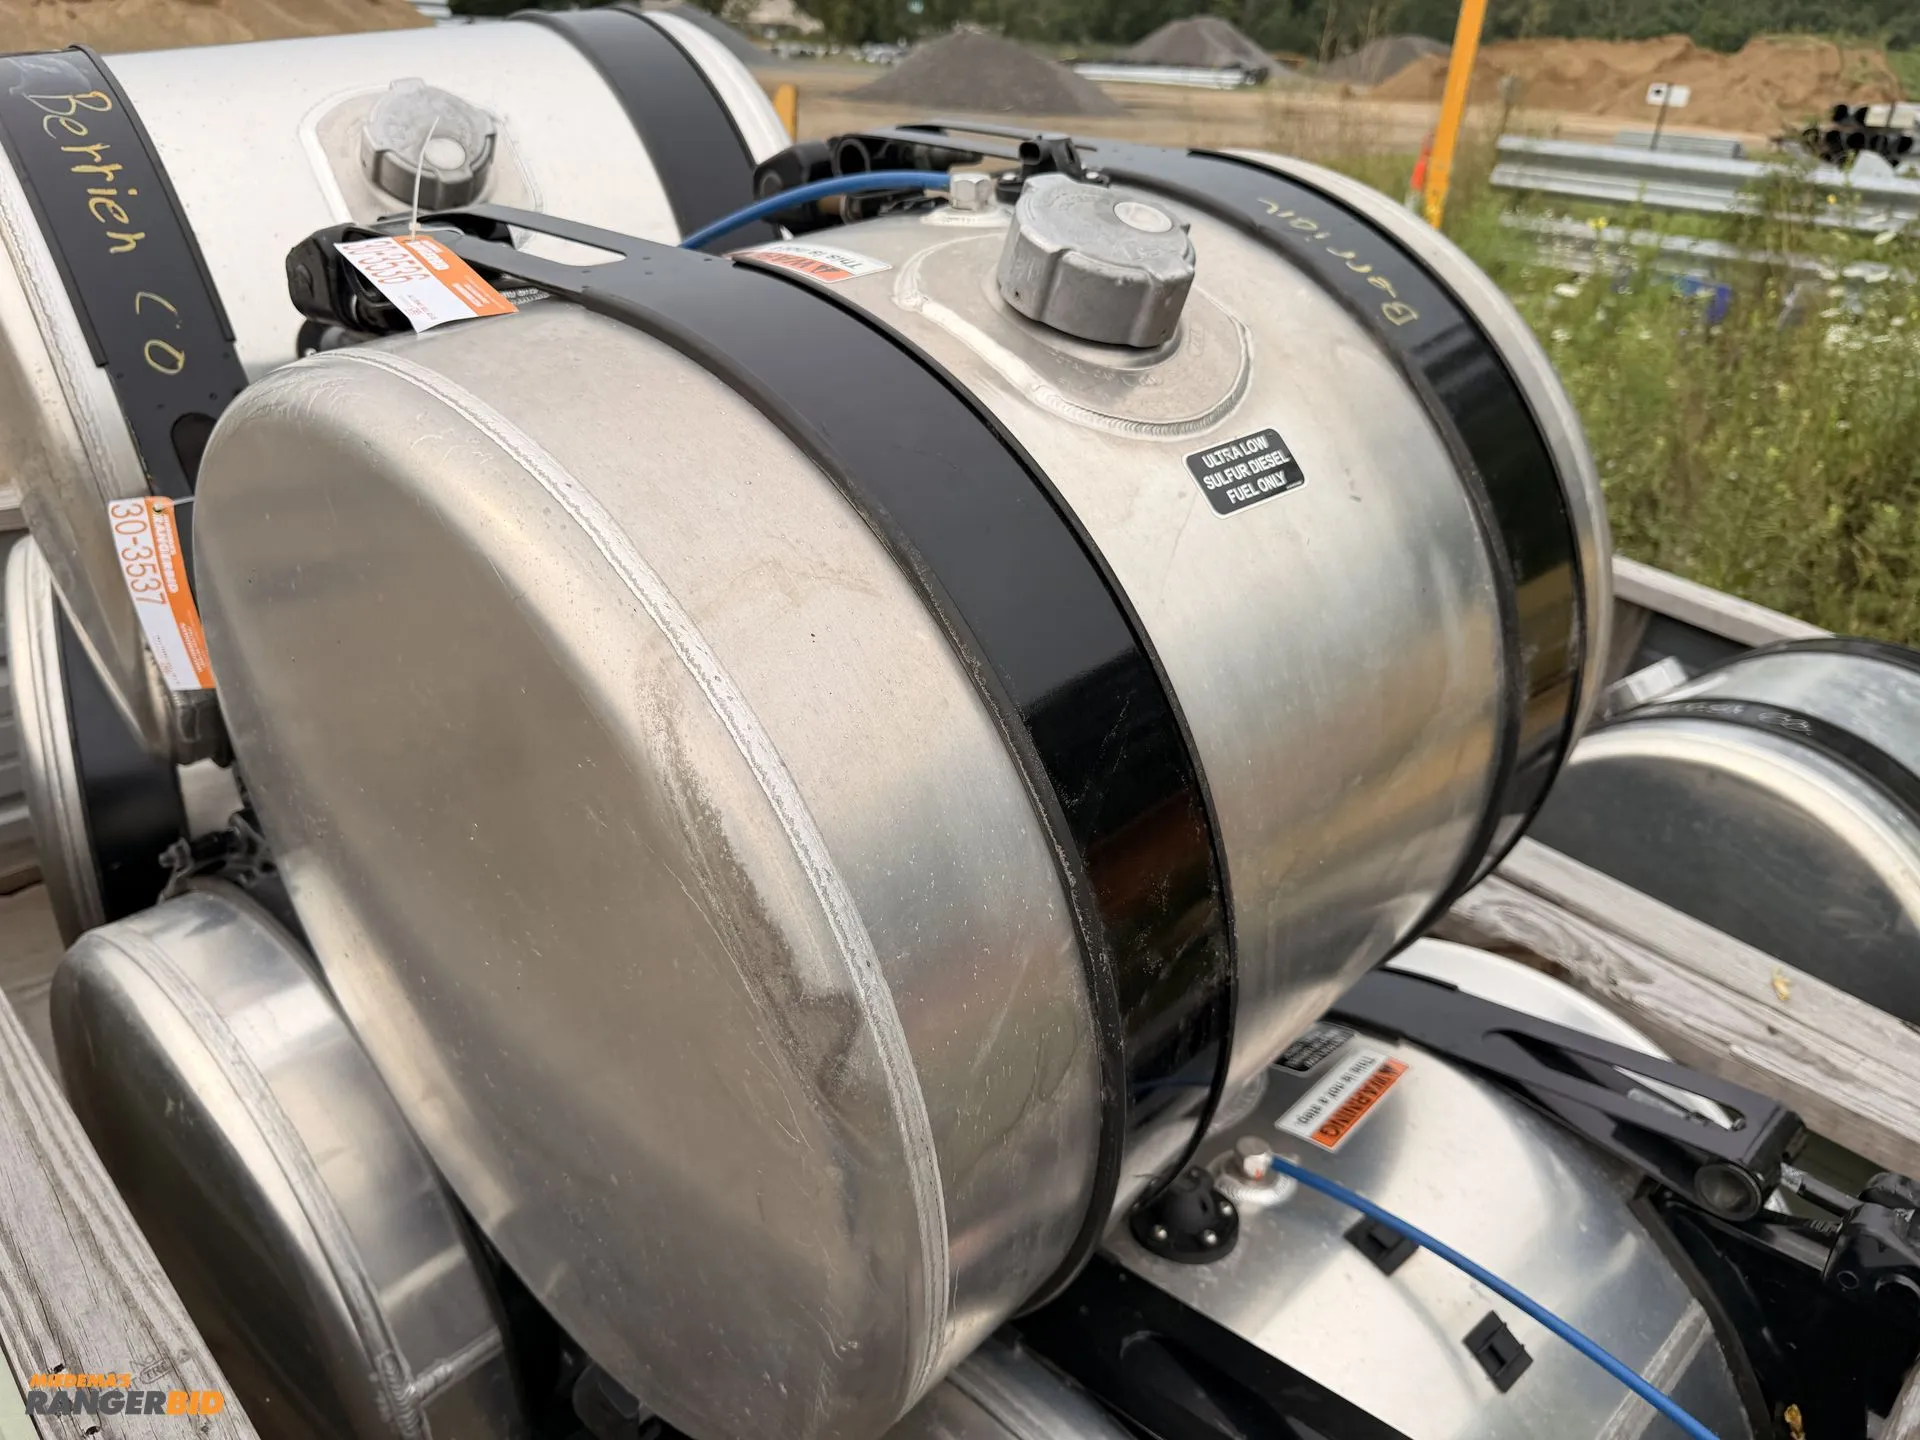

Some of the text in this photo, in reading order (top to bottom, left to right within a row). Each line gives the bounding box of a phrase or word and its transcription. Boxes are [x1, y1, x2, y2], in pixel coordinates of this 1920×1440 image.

[1201, 435, 1270, 469] ULTRA LOW
[1203, 449, 1292, 490] SULFUR DIESEL
[1226, 470, 1288, 504] FUEL ONLY
[111, 503, 168, 605] 30-3537
[1319, 1075, 1391, 1138] WARNING
